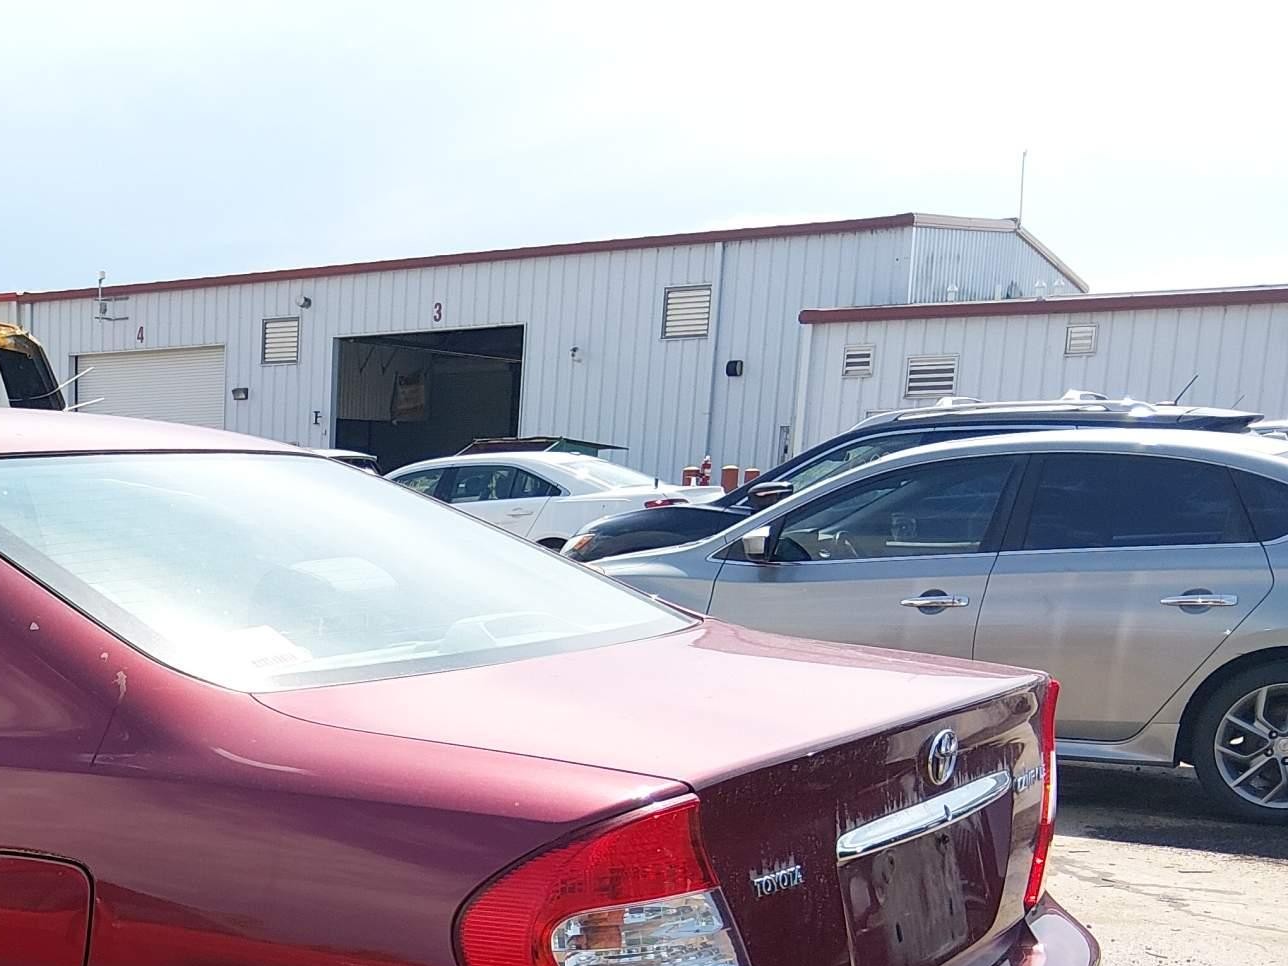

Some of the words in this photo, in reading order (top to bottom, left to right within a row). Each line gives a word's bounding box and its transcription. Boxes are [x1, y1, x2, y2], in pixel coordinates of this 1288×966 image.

[433, 302, 442, 323] 3
[136, 326, 144, 344] 4
[753, 865, 804, 898] TOYOTA
